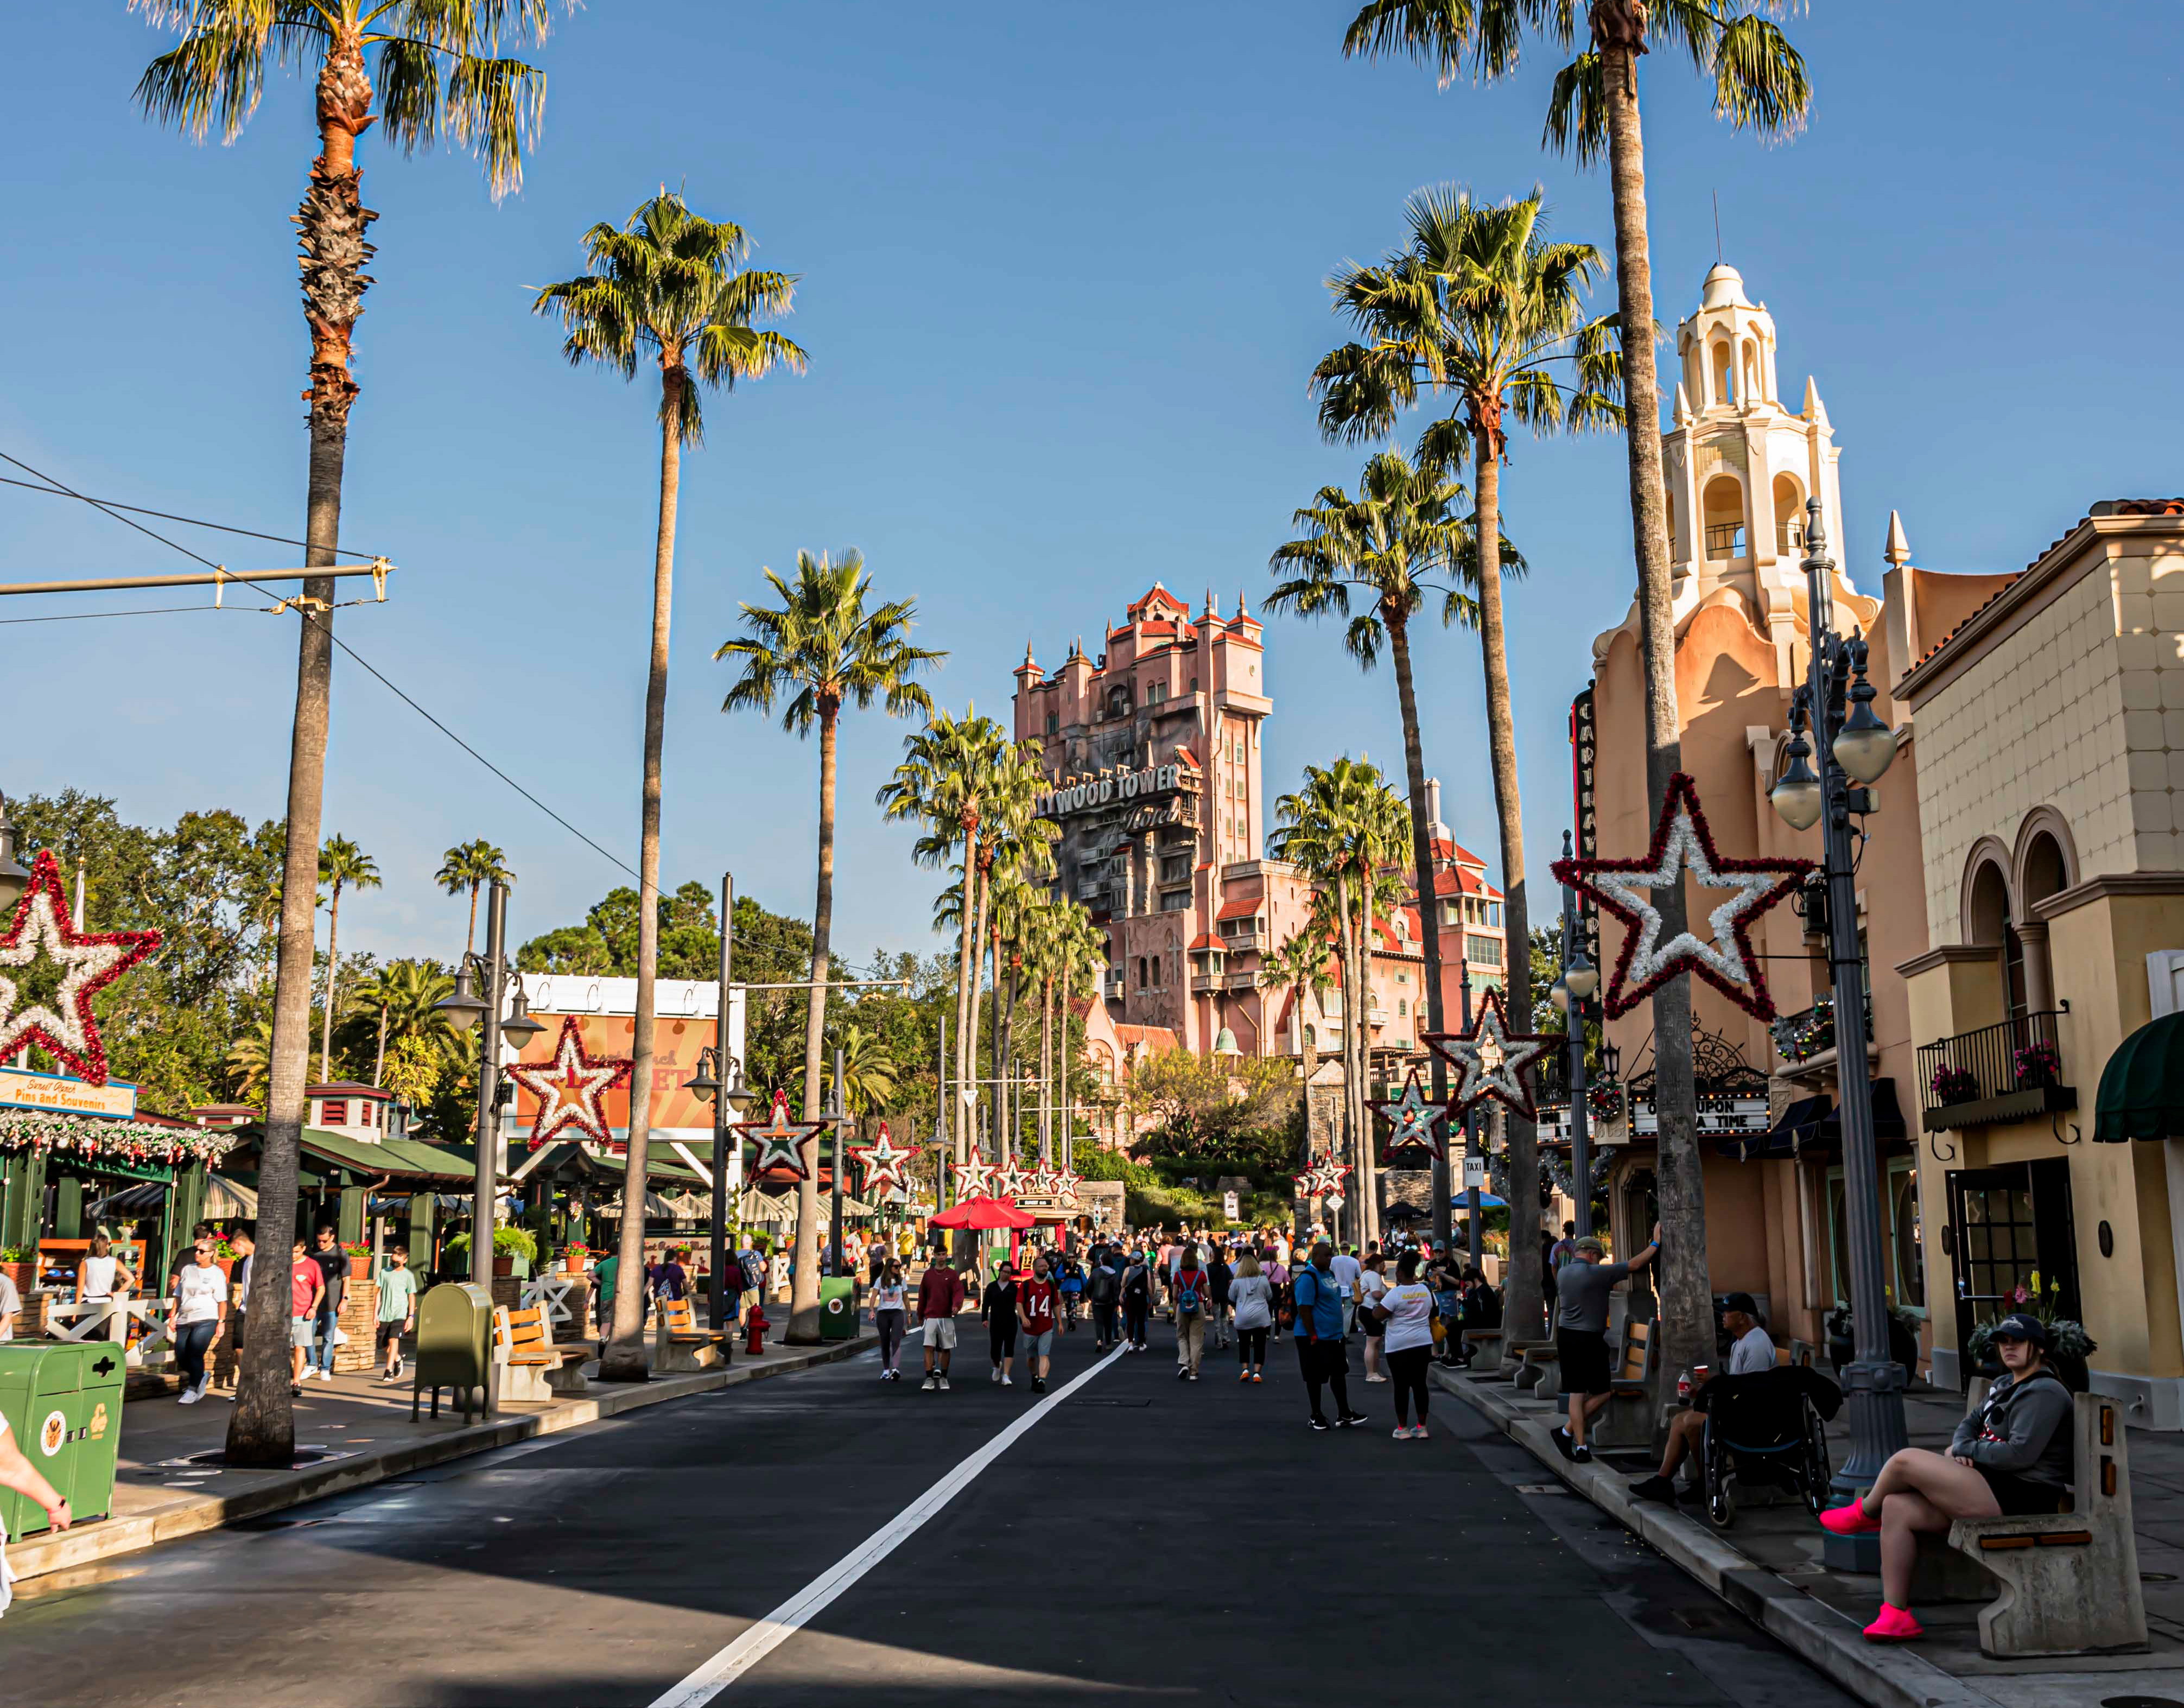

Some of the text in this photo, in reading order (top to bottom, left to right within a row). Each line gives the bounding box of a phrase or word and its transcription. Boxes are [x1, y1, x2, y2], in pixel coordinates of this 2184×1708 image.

[1579, 703, 1596, 852] CARTHAY
[1037, 763, 1181, 816] LYWOOD TOWER
[1122, 796, 1180, 830] Hotel
[27, 1079, 76, 1093] Sunset Ranch
[15, 1088, 105, 1110] Pins and Souvenirs
[1696, 1101, 1735, 1114] UPON
[1697, 1115, 1748, 1128] A TIME
[1466, 1162, 1481, 1171] TAXI
[1030, 1295, 1050, 1317] 14
